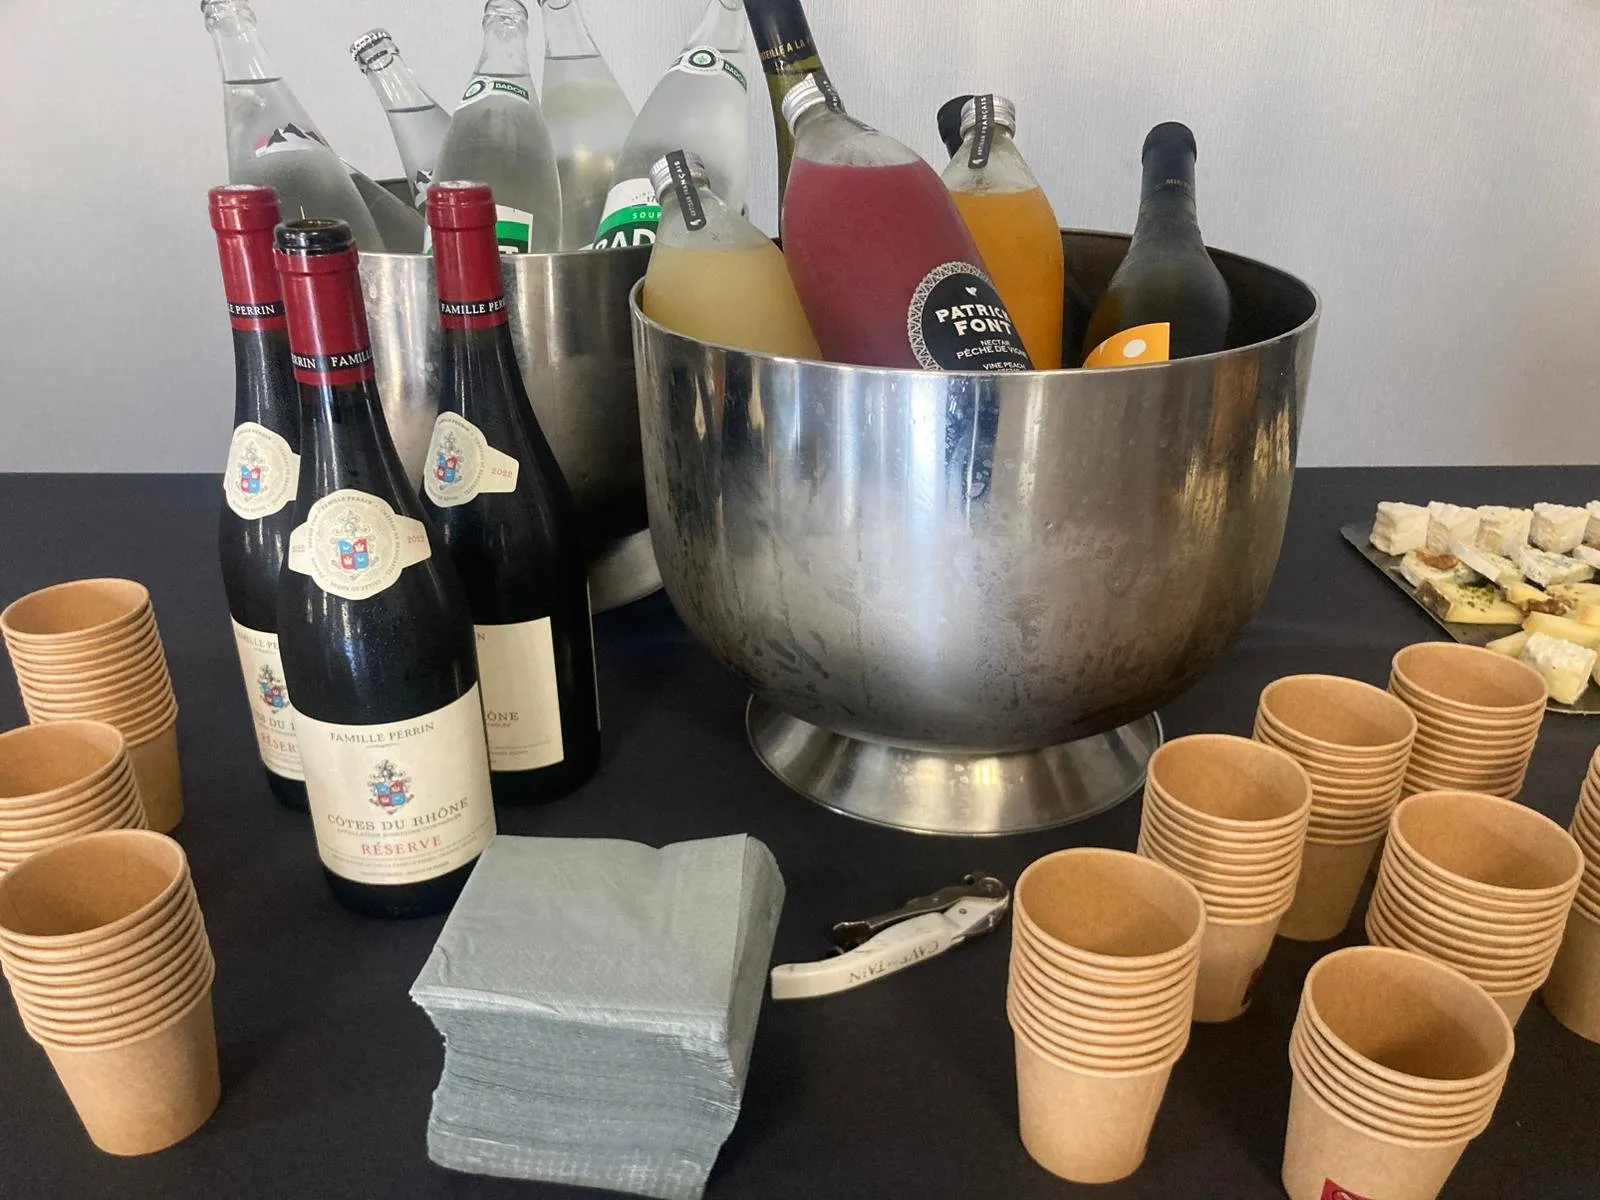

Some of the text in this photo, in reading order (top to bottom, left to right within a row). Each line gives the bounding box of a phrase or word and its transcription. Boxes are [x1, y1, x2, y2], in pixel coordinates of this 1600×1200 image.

[787, 42, 794, 53] A
[673, 160, 690, 196] FRANÇAIS
[236, 304, 276, 316] PERRIN
[440, 303, 487, 315] FAMILLE
[935, 303, 1012, 323] PATRICK
[953, 318, 1012, 337] FONT
[980, 339, 1010, 347] NECTAR
[956, 345, 995, 360] PÊCHE
[994, 345, 1009, 353] DE
[982, 362, 1003, 371] VINE
[1003, 361, 1027, 370] PEACH
[490, 467, 513, 479] 2022
[328, 721, 435, 744] FAMILLE PERRIN
[327, 797, 469, 832] CÔTES DU RHÔNE
[360, 834, 443, 856] RÉSERVE
